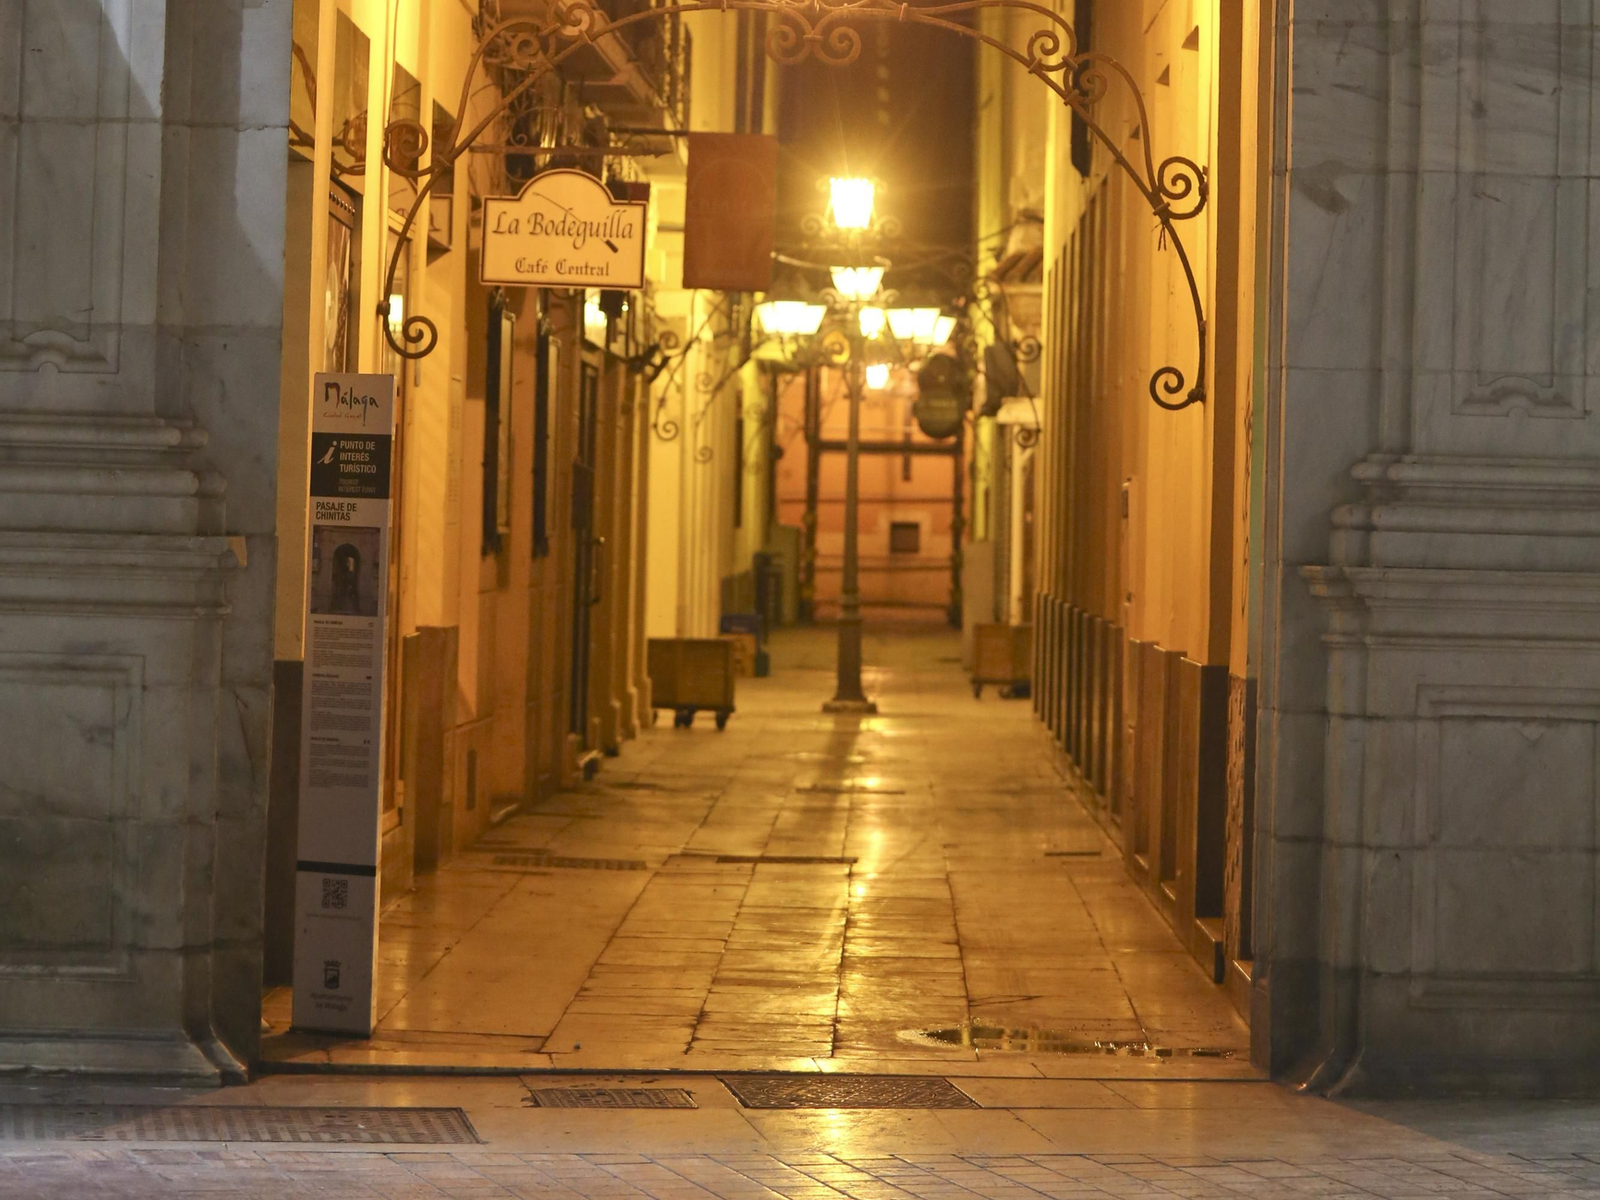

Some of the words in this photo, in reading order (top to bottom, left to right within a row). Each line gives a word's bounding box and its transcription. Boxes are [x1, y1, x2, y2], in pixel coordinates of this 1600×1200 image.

[492, 210, 519, 235] La
[527, 207, 633, 250] Bodeguilla
[515, 257, 548, 274] Café
[555, 258, 609, 277] Central
[324, 382, 379, 427] Málaga
[340, 440, 364, 450] PUNTO
[365, 441, 376, 451] DE
[339, 451, 370, 462] INTERÉS
[339, 463, 377, 474] TURÍSTICO
[316, 501, 345, 512] PASAJE
[346, 502, 357, 512] DE
[315, 511, 351, 521] CHINITAS
